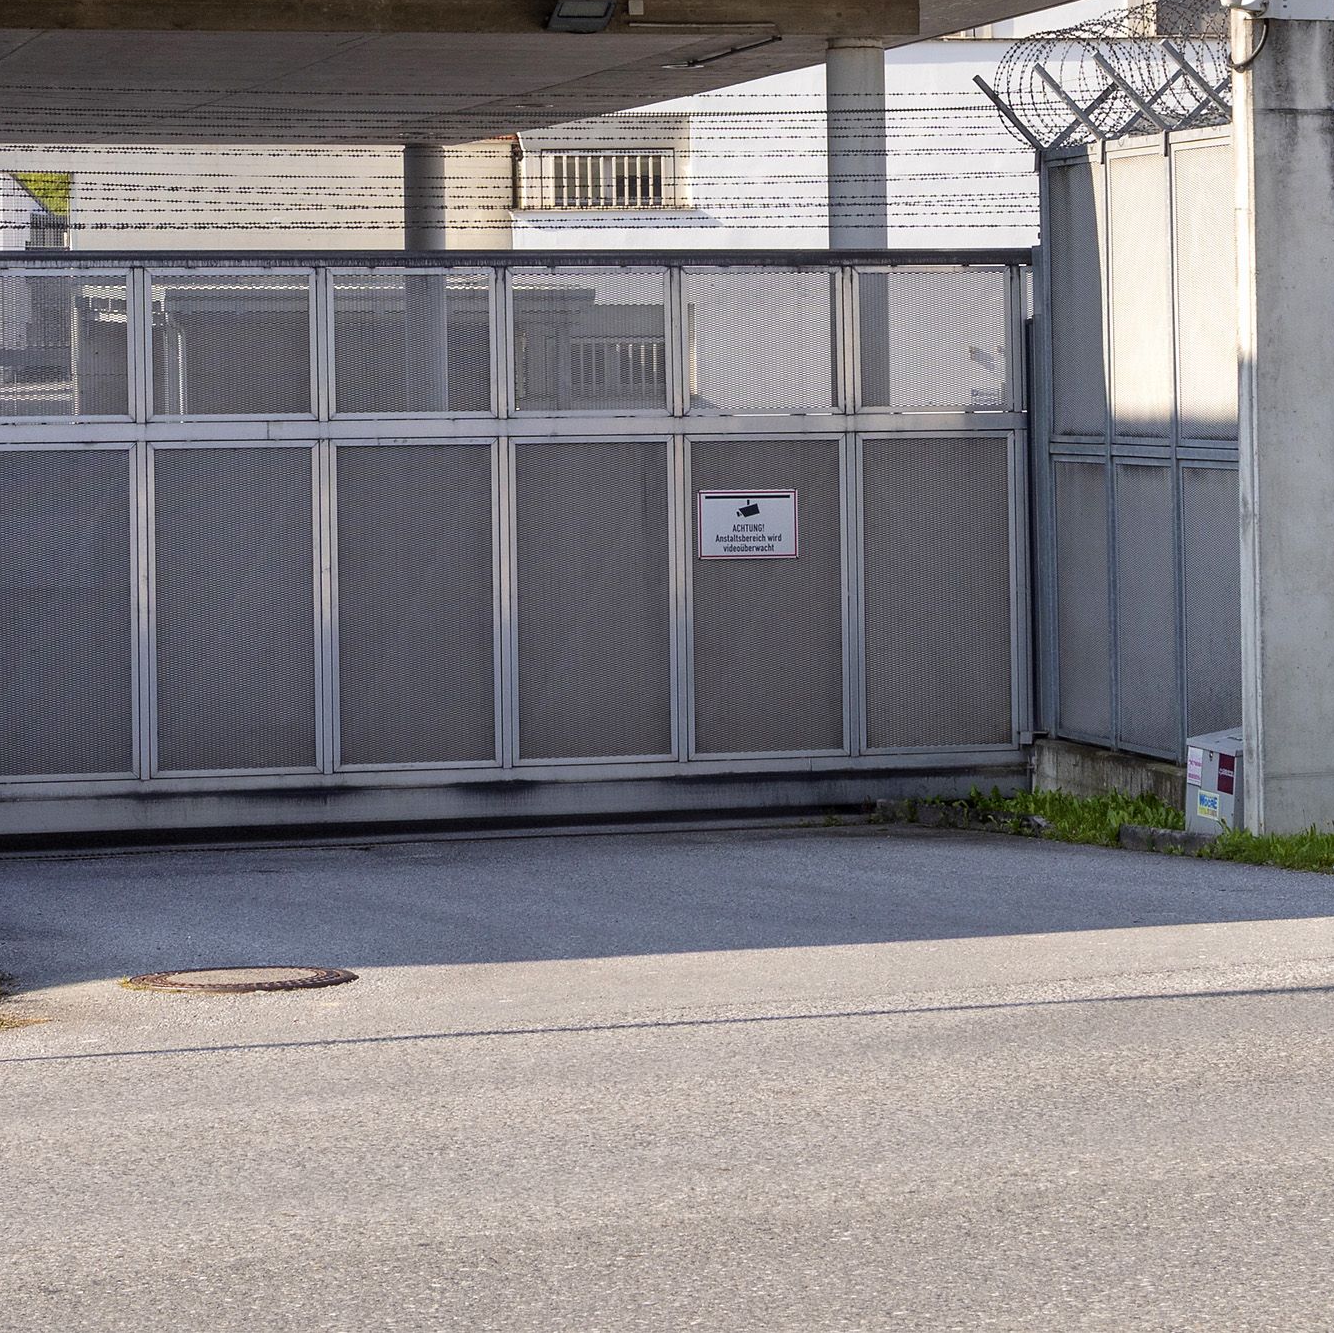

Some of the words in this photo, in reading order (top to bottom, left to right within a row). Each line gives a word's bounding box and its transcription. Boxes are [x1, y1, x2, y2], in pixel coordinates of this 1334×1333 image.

[732, 524, 765, 532] ACHTUNG!
[715, 534, 766, 543] Anstaltsbereich
[768, 534, 782, 542] wird
[723, 544, 774, 552] videoüberwacht
